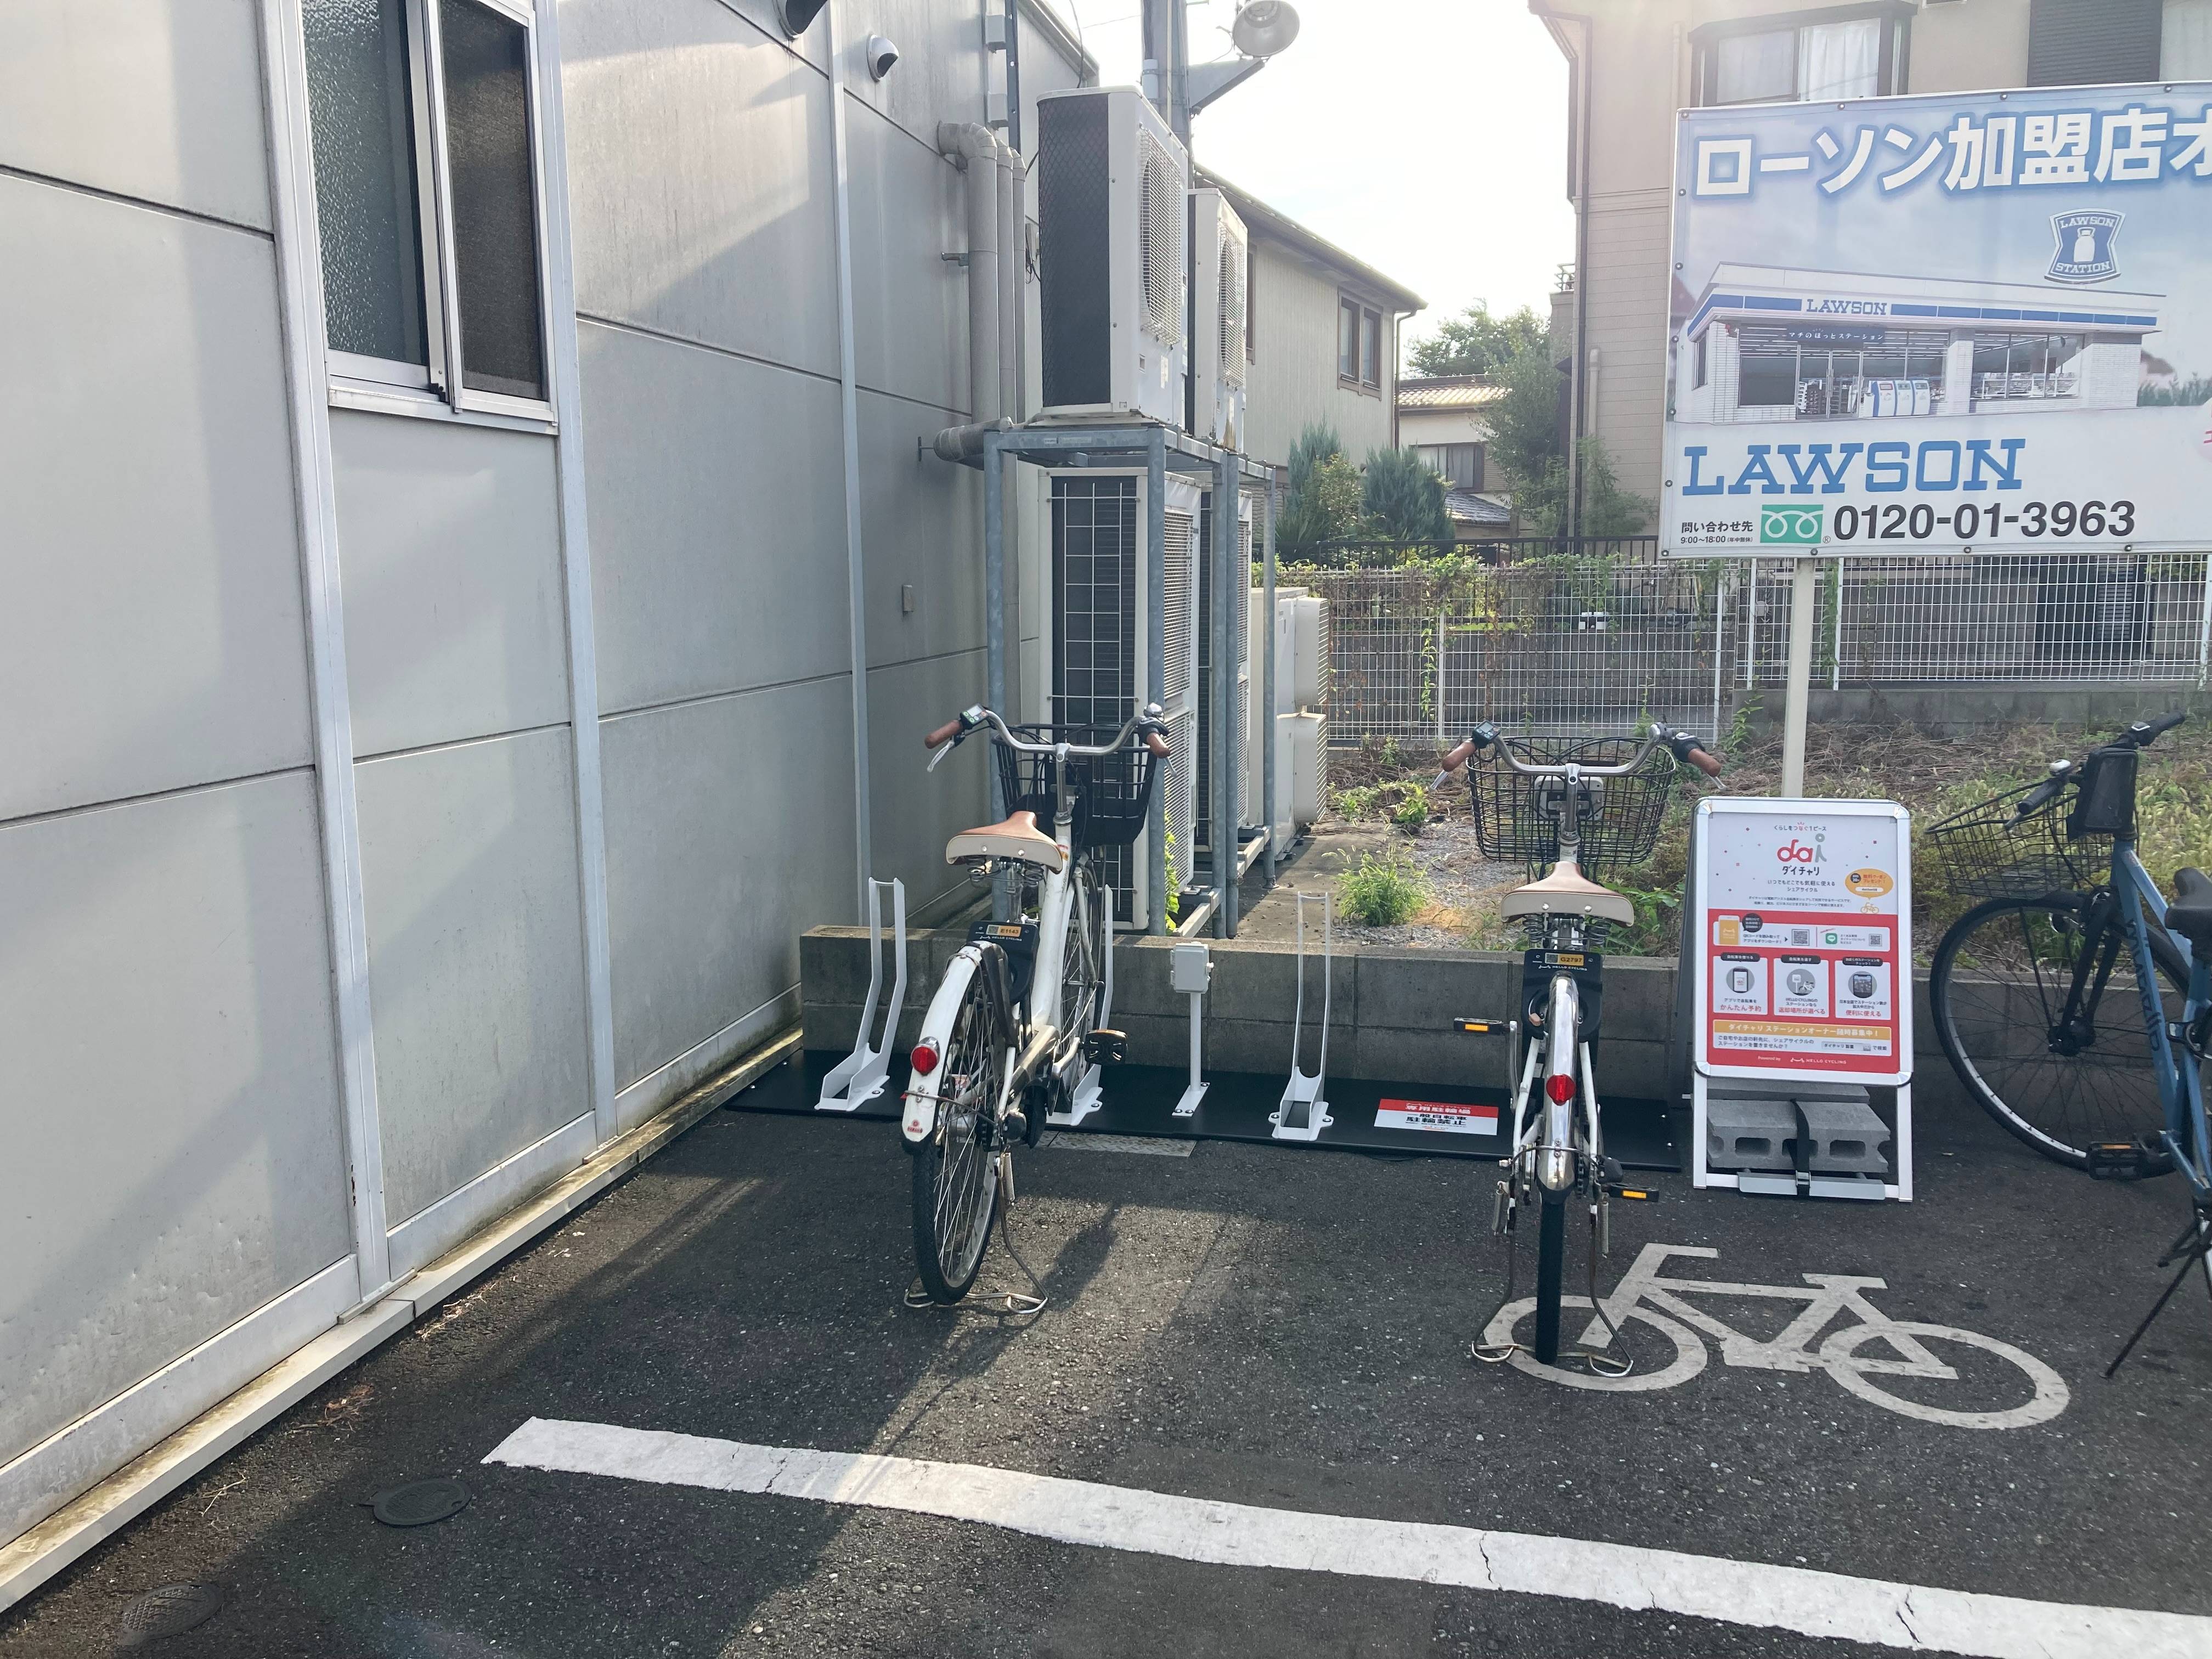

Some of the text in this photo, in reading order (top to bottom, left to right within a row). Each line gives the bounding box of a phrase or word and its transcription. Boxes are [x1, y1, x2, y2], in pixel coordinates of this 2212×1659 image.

[2060, 216, 2115, 229] LAWSON
[2055, 261, 2111, 274] STATION
[1806, 299, 1887, 315] LAWSON
[1788, 331, 1883, 340] マチのほっとステーション
[1682, 438, 2026, 496] LAWSON
[1834, 500, 2135, 540] 0120-01-3963
[1681, 521, 1753, 534] 問い合わせ先
[1782, 866, 1820, 876] ダイチャリ
[1720, 1004, 1762, 1012] かんたん予約
[1729, 1024, 1763, 1032] ダイチャリ
